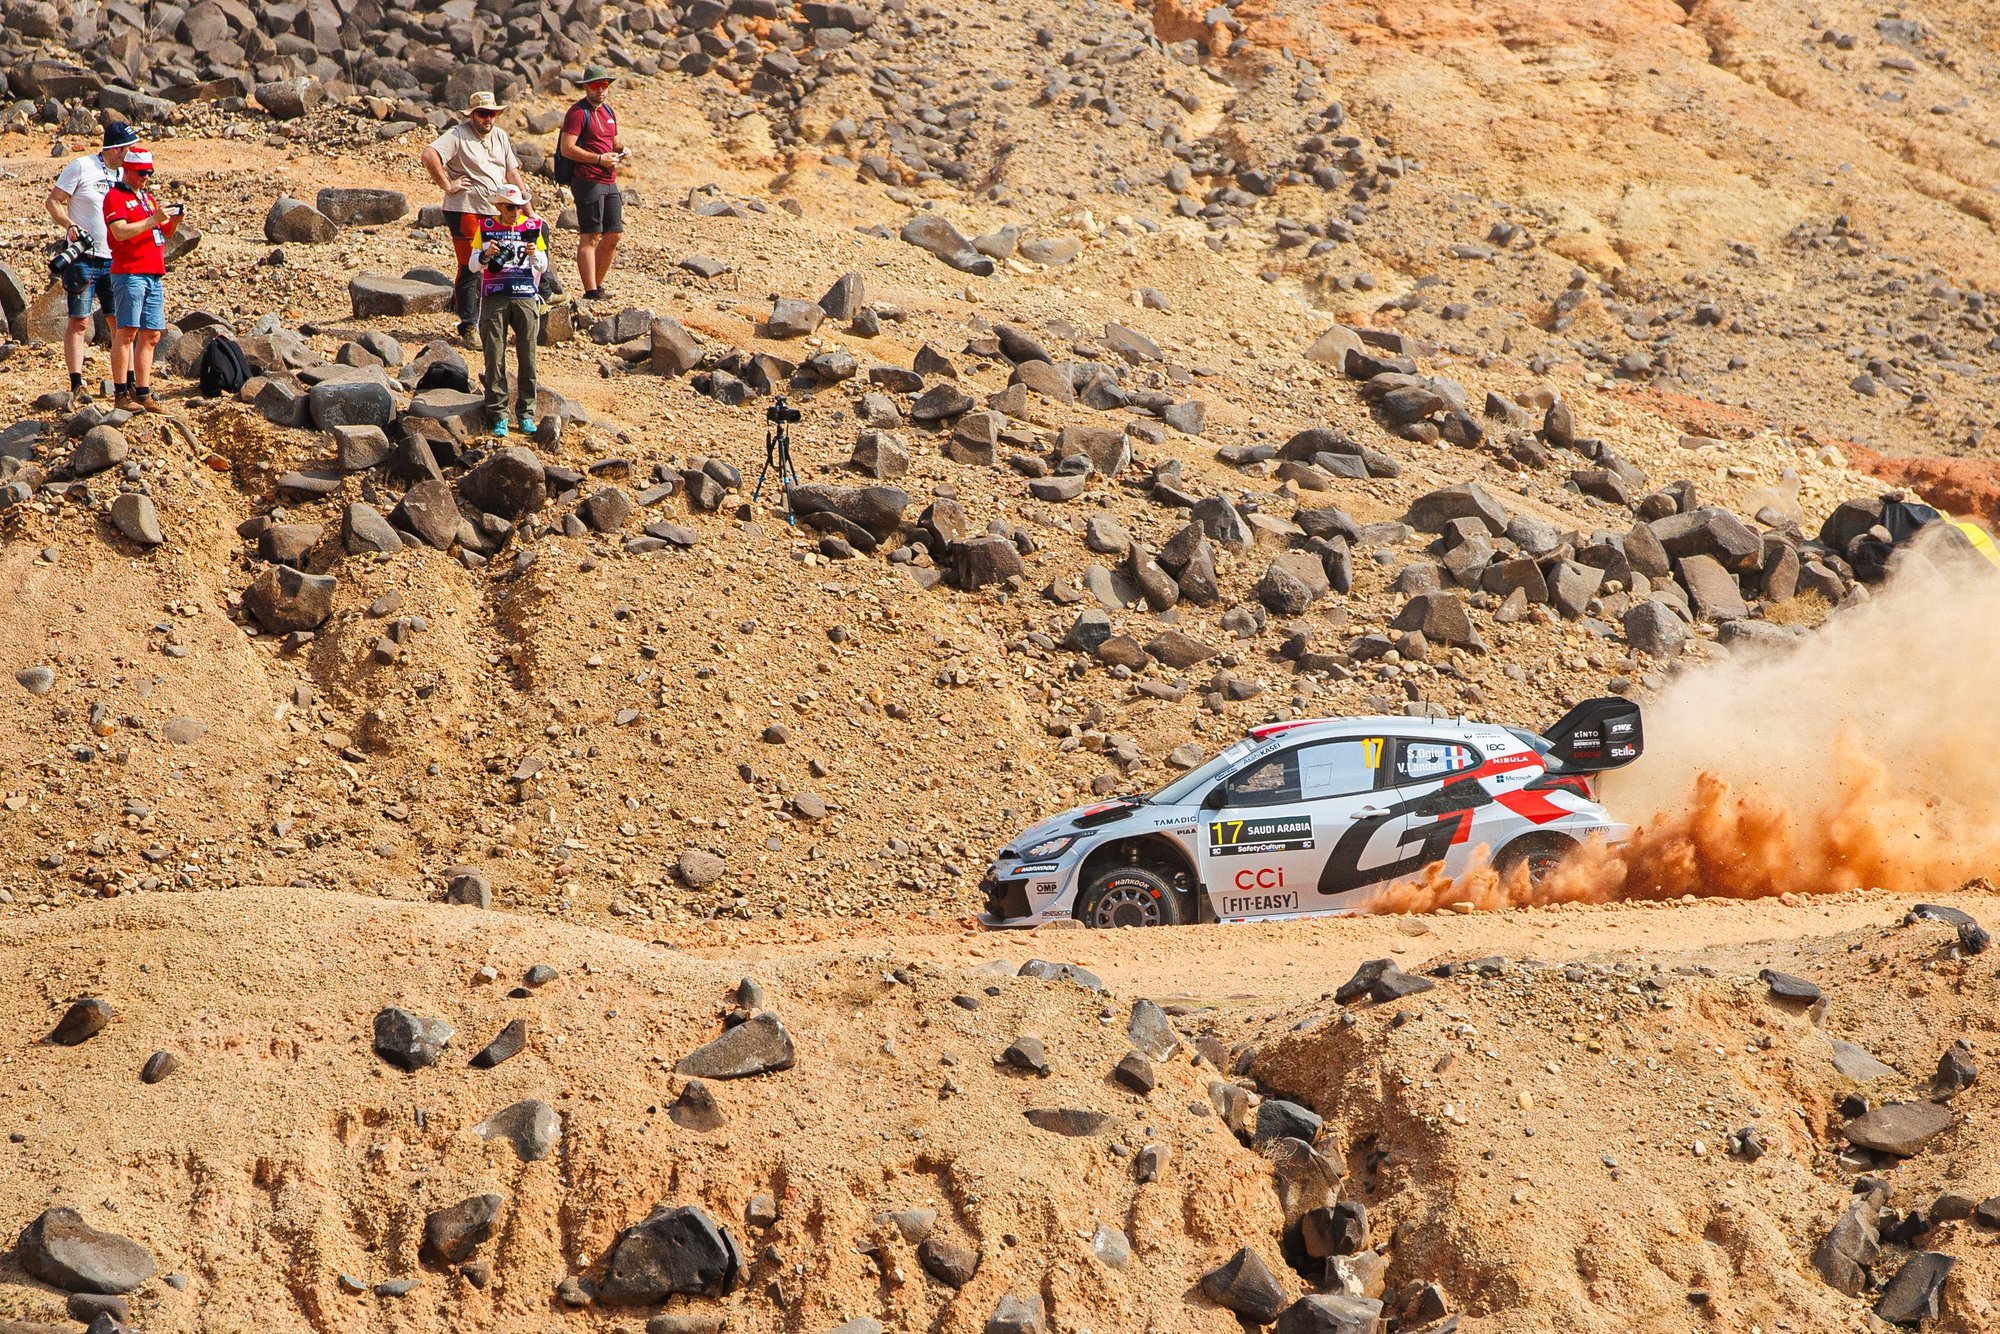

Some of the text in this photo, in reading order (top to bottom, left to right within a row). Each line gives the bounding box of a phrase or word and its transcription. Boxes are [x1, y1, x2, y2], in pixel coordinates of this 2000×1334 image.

[1574, 730, 1599, 738] KINTO
[1361, 738, 1385, 769] 17
[1611, 744, 1636, 757] Stilo
[1492, 756, 1529, 765] NIBULA
[1154, 816, 1197, 826] TAMADIC
[1212, 820, 1244, 845] 17
[1247, 822, 1311, 836] SAUDI ARABIA
[1237, 843, 1286, 853] SafetyCulture
[1302, 840, 1312, 848] SC
[1036, 884, 1057, 892] OMP
